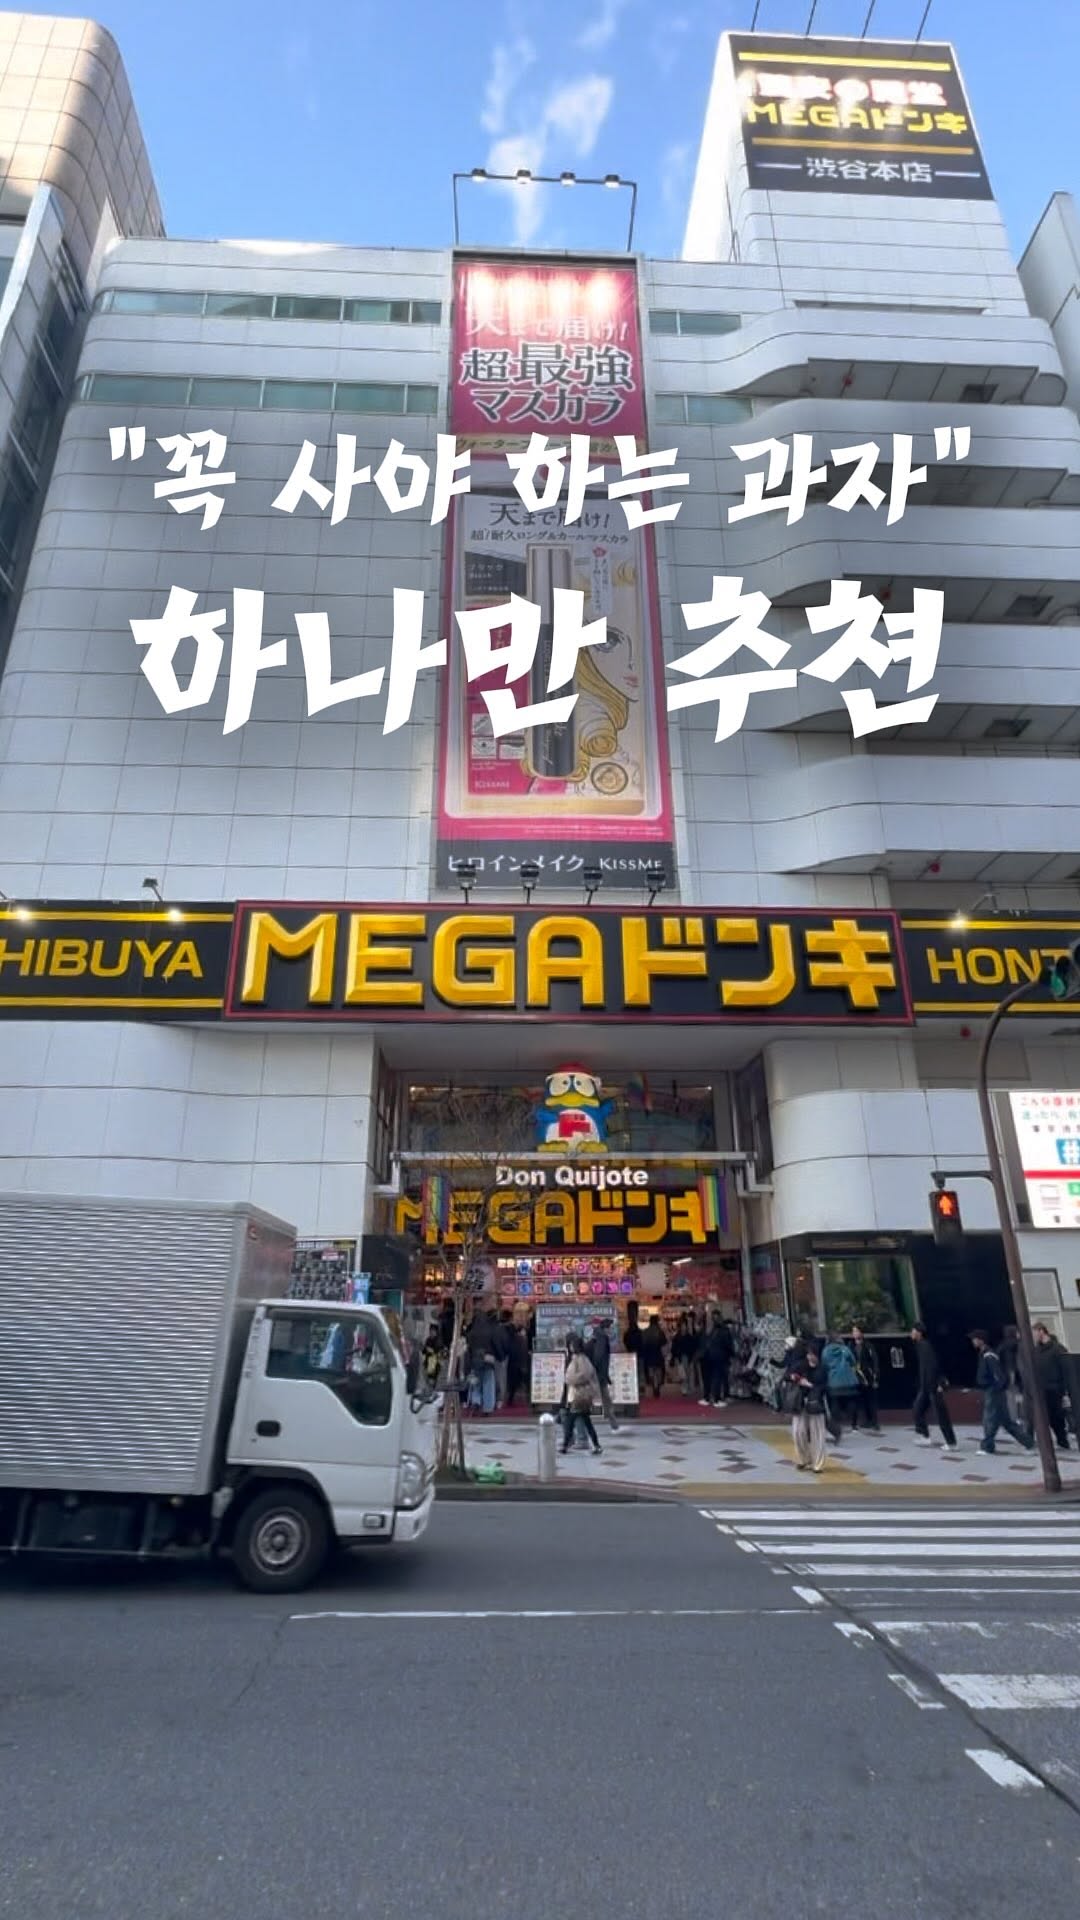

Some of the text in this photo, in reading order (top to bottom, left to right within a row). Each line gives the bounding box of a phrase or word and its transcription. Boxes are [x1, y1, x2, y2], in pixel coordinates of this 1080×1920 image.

[747, 102, 967, 134] MEGAドンキ
[806, 157, 932, 183] 渋谷本店
[459, 341, 635, 391] 超最強
[471, 387, 624, 425] マスカラ
[448, 854, 584, 872] ヒロインメイク
[242, 912, 897, 1009] MEGAドンキ
[495, 1165, 649, 1190] Don Quijote
